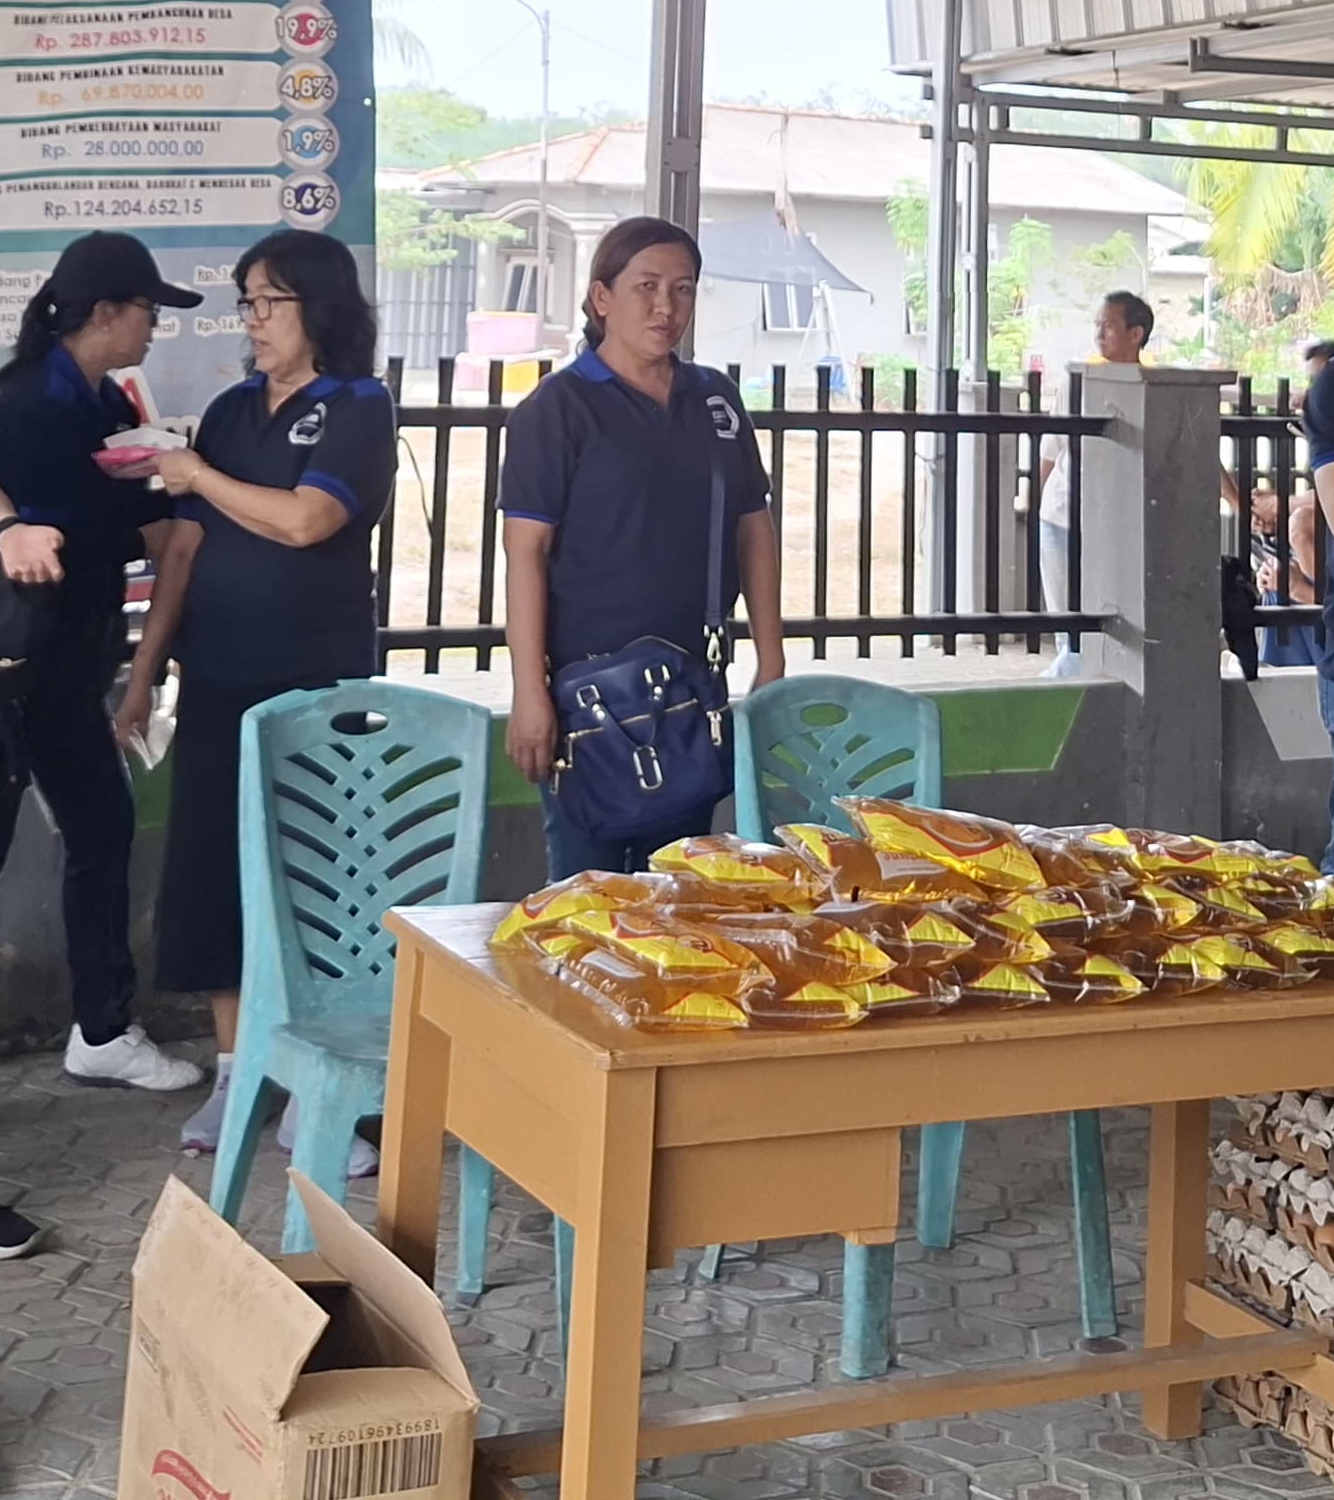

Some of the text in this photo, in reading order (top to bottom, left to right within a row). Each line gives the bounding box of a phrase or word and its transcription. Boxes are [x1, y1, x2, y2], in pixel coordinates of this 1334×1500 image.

[275, 16, 337, 40] 19,9%
[34, 33, 63, 52] Rp.
[281, 76, 333, 99] 4,8%
[42, 142, 71, 160] Rp.
[282, 130, 335, 154] 1,9%
[282, 187, 336, 210] 8,6%
